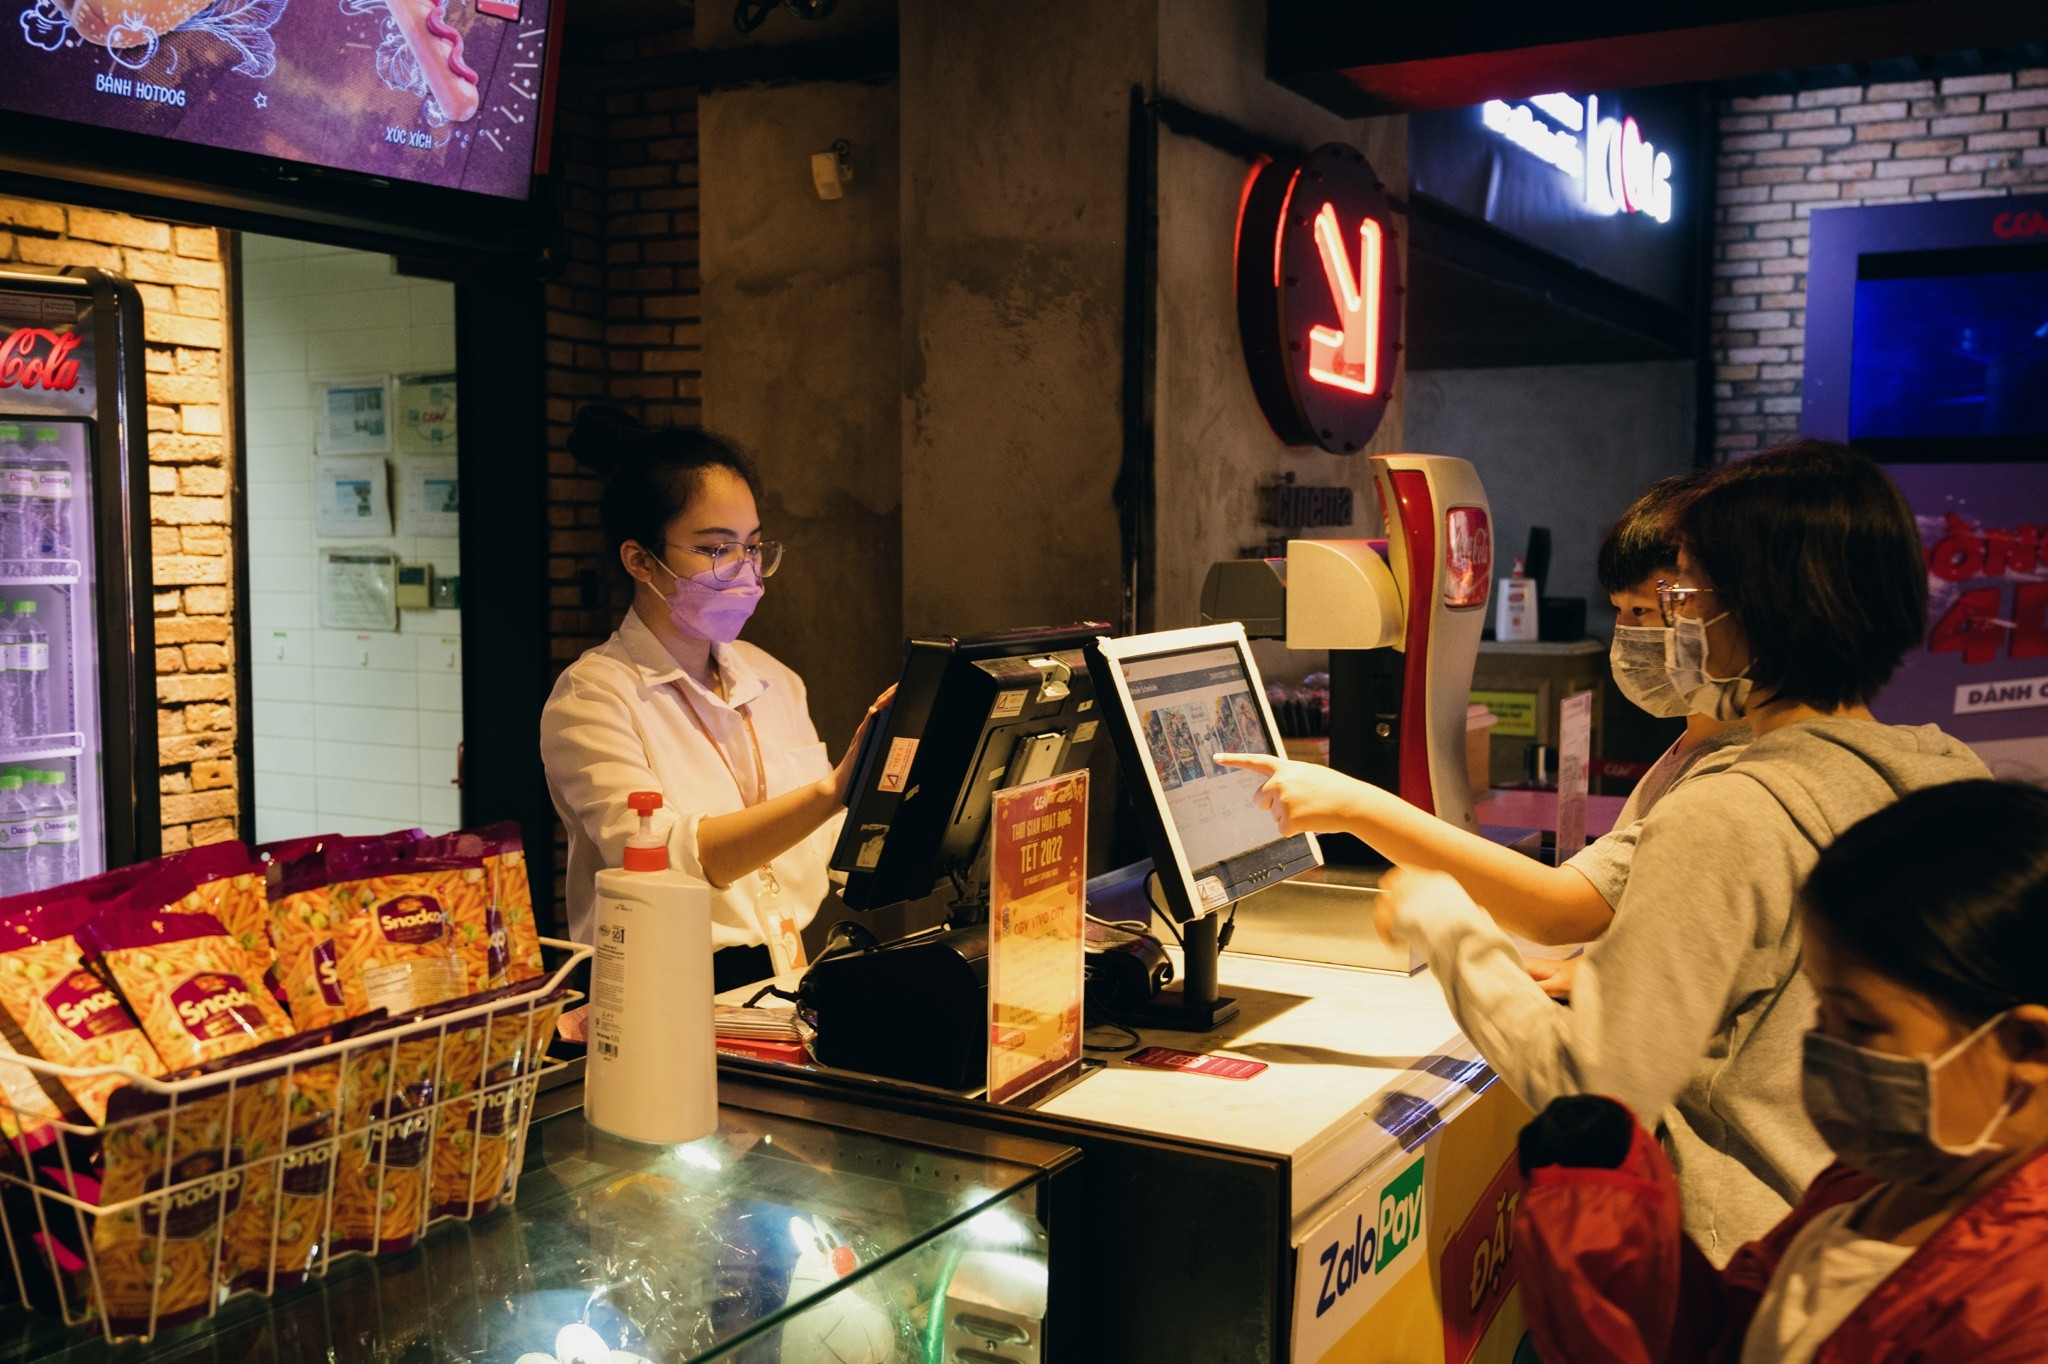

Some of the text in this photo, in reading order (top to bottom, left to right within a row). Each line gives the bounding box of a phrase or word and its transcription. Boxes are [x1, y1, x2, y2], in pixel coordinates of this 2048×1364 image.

[95, 73, 186, 107] BÁNH HOTDOG
[385, 126, 432, 149] XÚC XÍCH
[1922, 511, 2048, 582] ÒN
[1968, 682, 2032, 706] DÀNH
[1040, 834, 1063, 867] 2022
[1014, 904, 1066, 935] CGV VIVO CITY
[1316, 1184, 1422, 1319] ZaloPay
